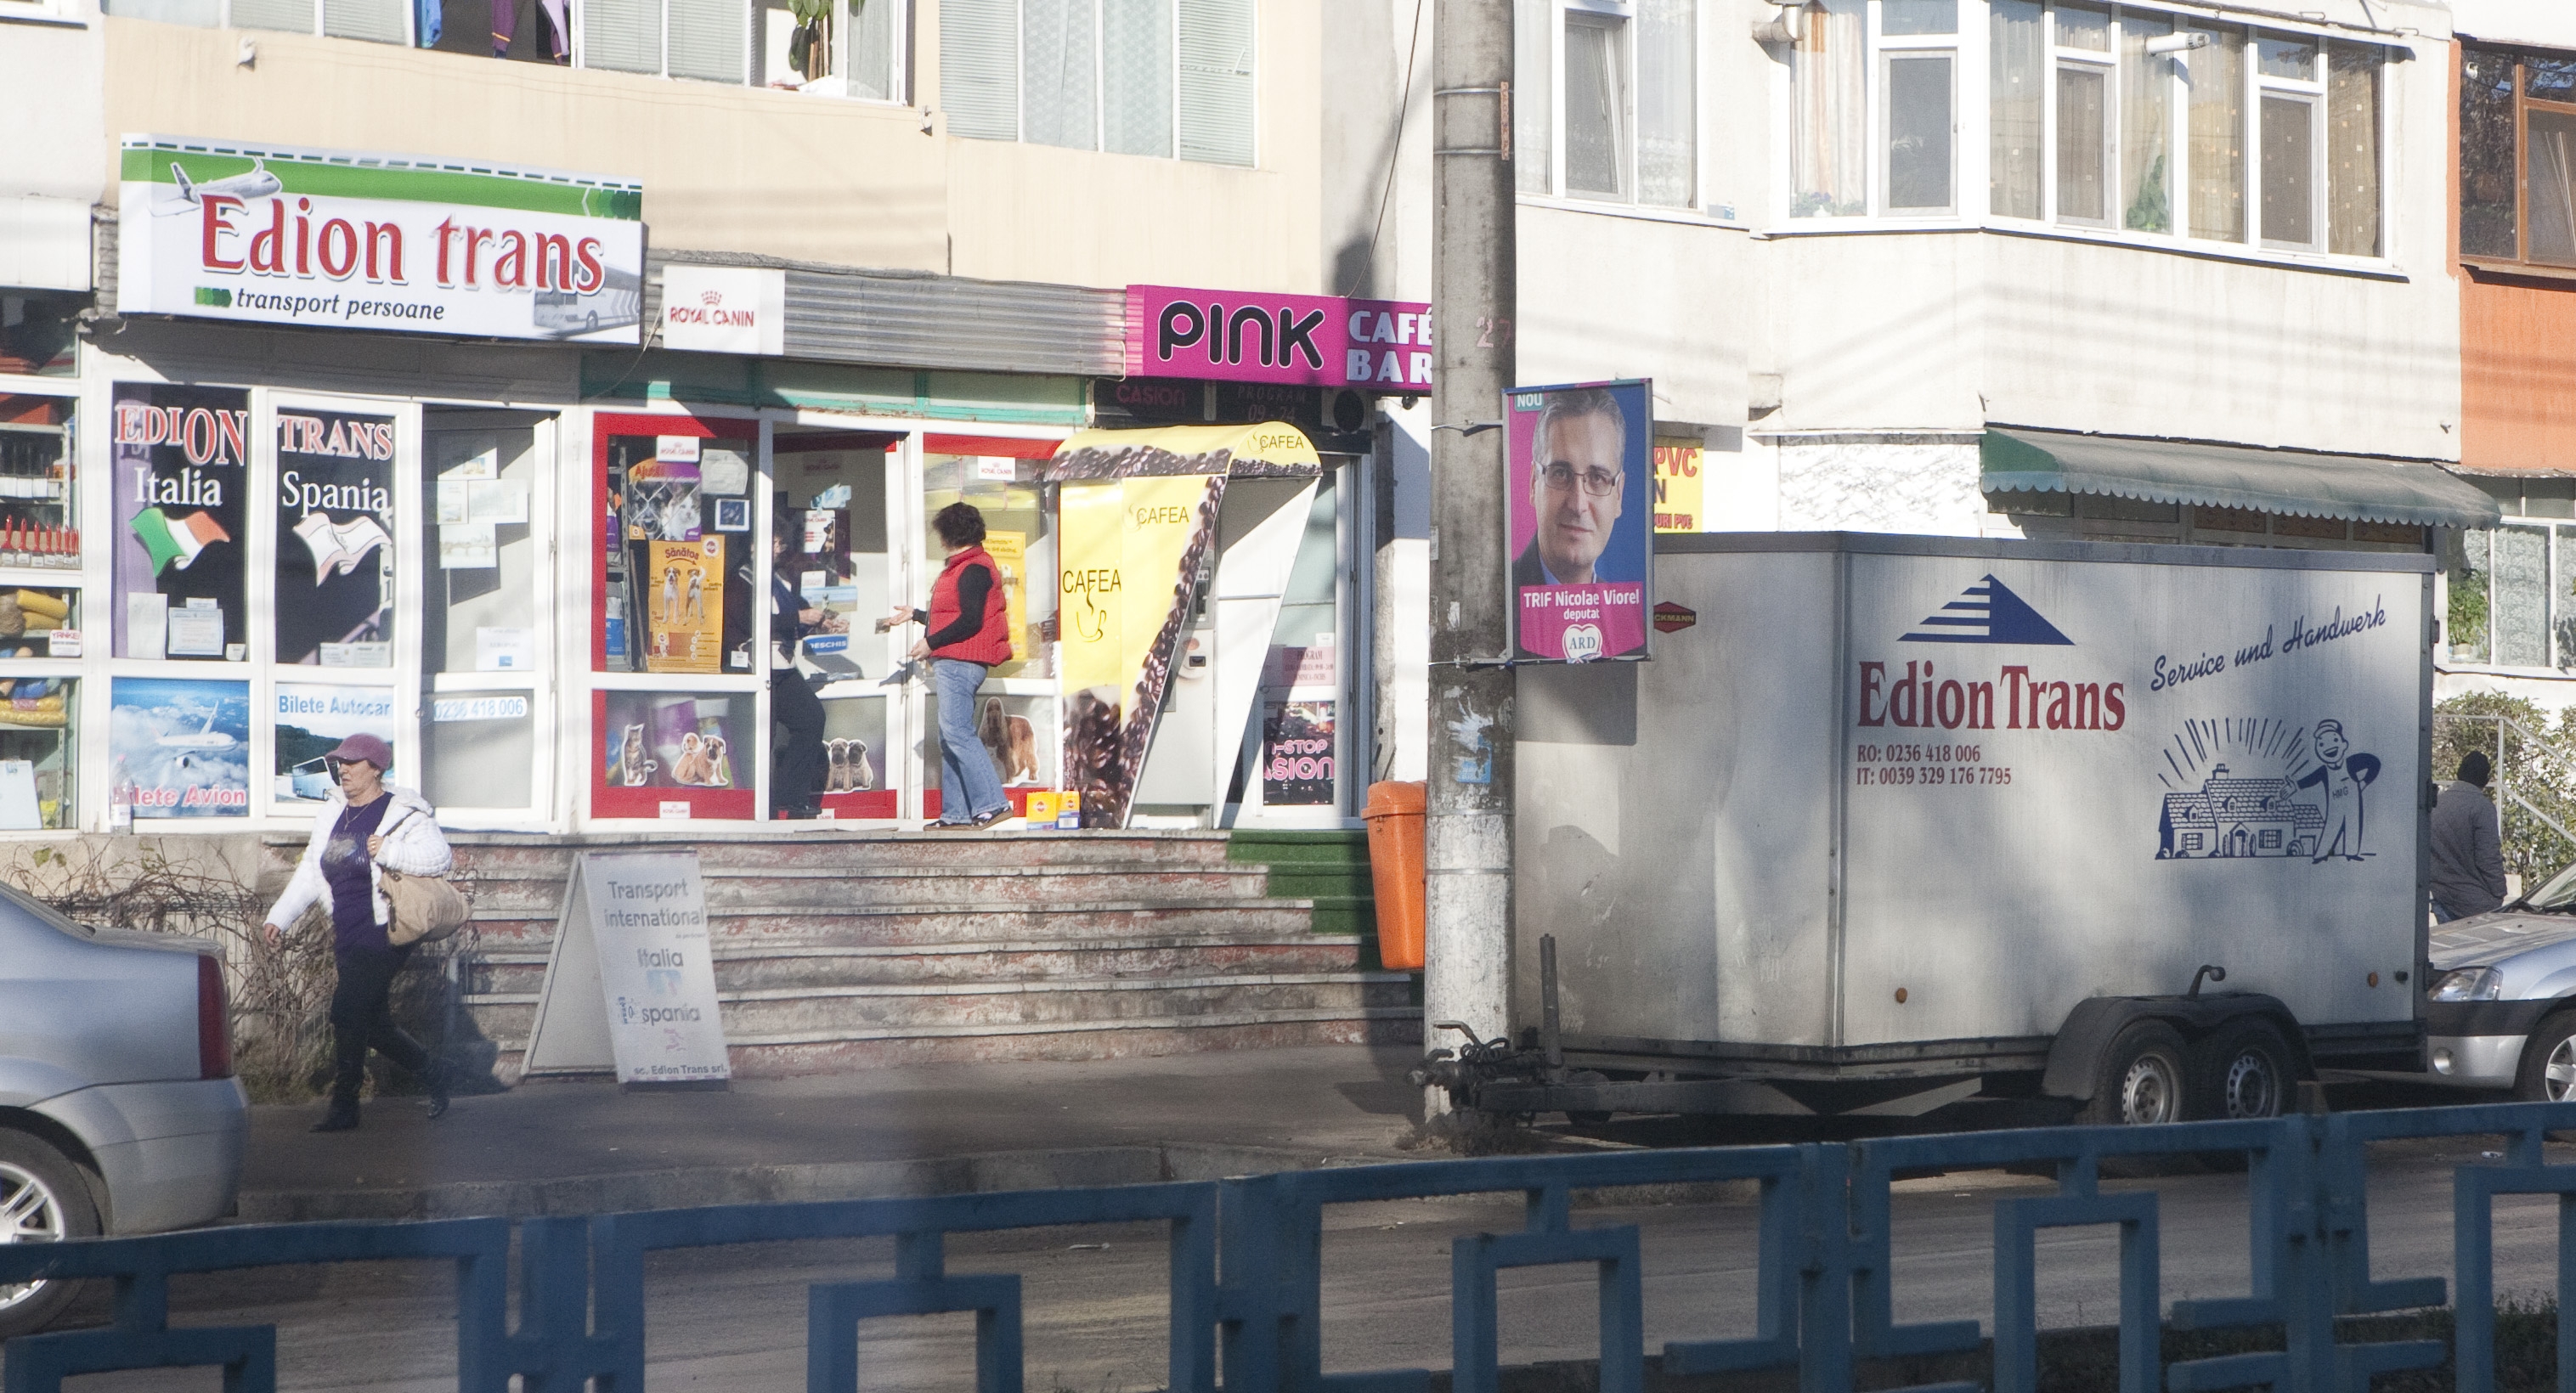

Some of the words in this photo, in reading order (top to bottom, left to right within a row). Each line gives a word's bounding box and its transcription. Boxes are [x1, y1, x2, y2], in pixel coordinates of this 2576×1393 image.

[200, 194, 407, 284] Edion
[436, 214, 606, 294] trans
[237, 287, 340, 317] transport
[345, 296, 445, 321] persoane
[669, 307, 709, 324] ROYAL
[713, 309, 754, 327] CANIN
[1347, 349, 1432, 385] BAR
[1237, 385, 1307, 403] PROGRAM
[1517, 393, 1543, 408] NOU
[114, 403, 248, 466] EDION
[277, 414, 393, 460] TRANS
[1260, 435, 1304, 449] CAFEA
[1653, 447, 1698, 478] PVC
[133, 466, 223, 506] Italia
[281, 471, 389, 519] Spania
[1137, 506, 1189, 525] CAFEA
[1674, 514, 1693, 530] PVC
[1063, 569, 1121, 594] CAFEA
[1524, 592, 1551, 607] TRIF
[1555, 589, 1600, 606] Nicolae
[1603, 588, 1640, 606] Viorel
[1563, 608, 1600, 623] deputat
[1569, 636, 1596, 651] ARD
[2150, 652, 2225, 691] Service
[2234, 624, 2274, 668] und
[2282, 593, 2387, 654] Handwerk
[279, 695, 325, 714] Bilete
[330, 695, 391, 717] Autocar
[434, 699, 466, 719] 0236
[472, 698, 496, 717] 418
[500, 697, 524, 716] 006
[1856, 744, 1882, 763] RO:
[1886, 744, 1922, 763] 0236
[1925, 743, 1952, 763] 418
[1955, 744, 1980, 763] 006
[1856, 767, 1875, 786] IT:
[1879, 767, 1915, 785] 0039
[1918, 767, 1945, 785] 329
[1950, 767, 1974, 784] 176
[1979, 767, 2012, 785] 7795
[182, 784, 246, 807] Avion
[2332, 786, 2349, 800] HMG
[607, 877, 689, 902] Transport
[604, 906, 704, 928] international
[638, 948, 684, 968] Italia
[641, 1002, 702, 1026] spania
[650, 1065, 680, 1075] Edion
[681, 1064, 709, 1074] Trans
